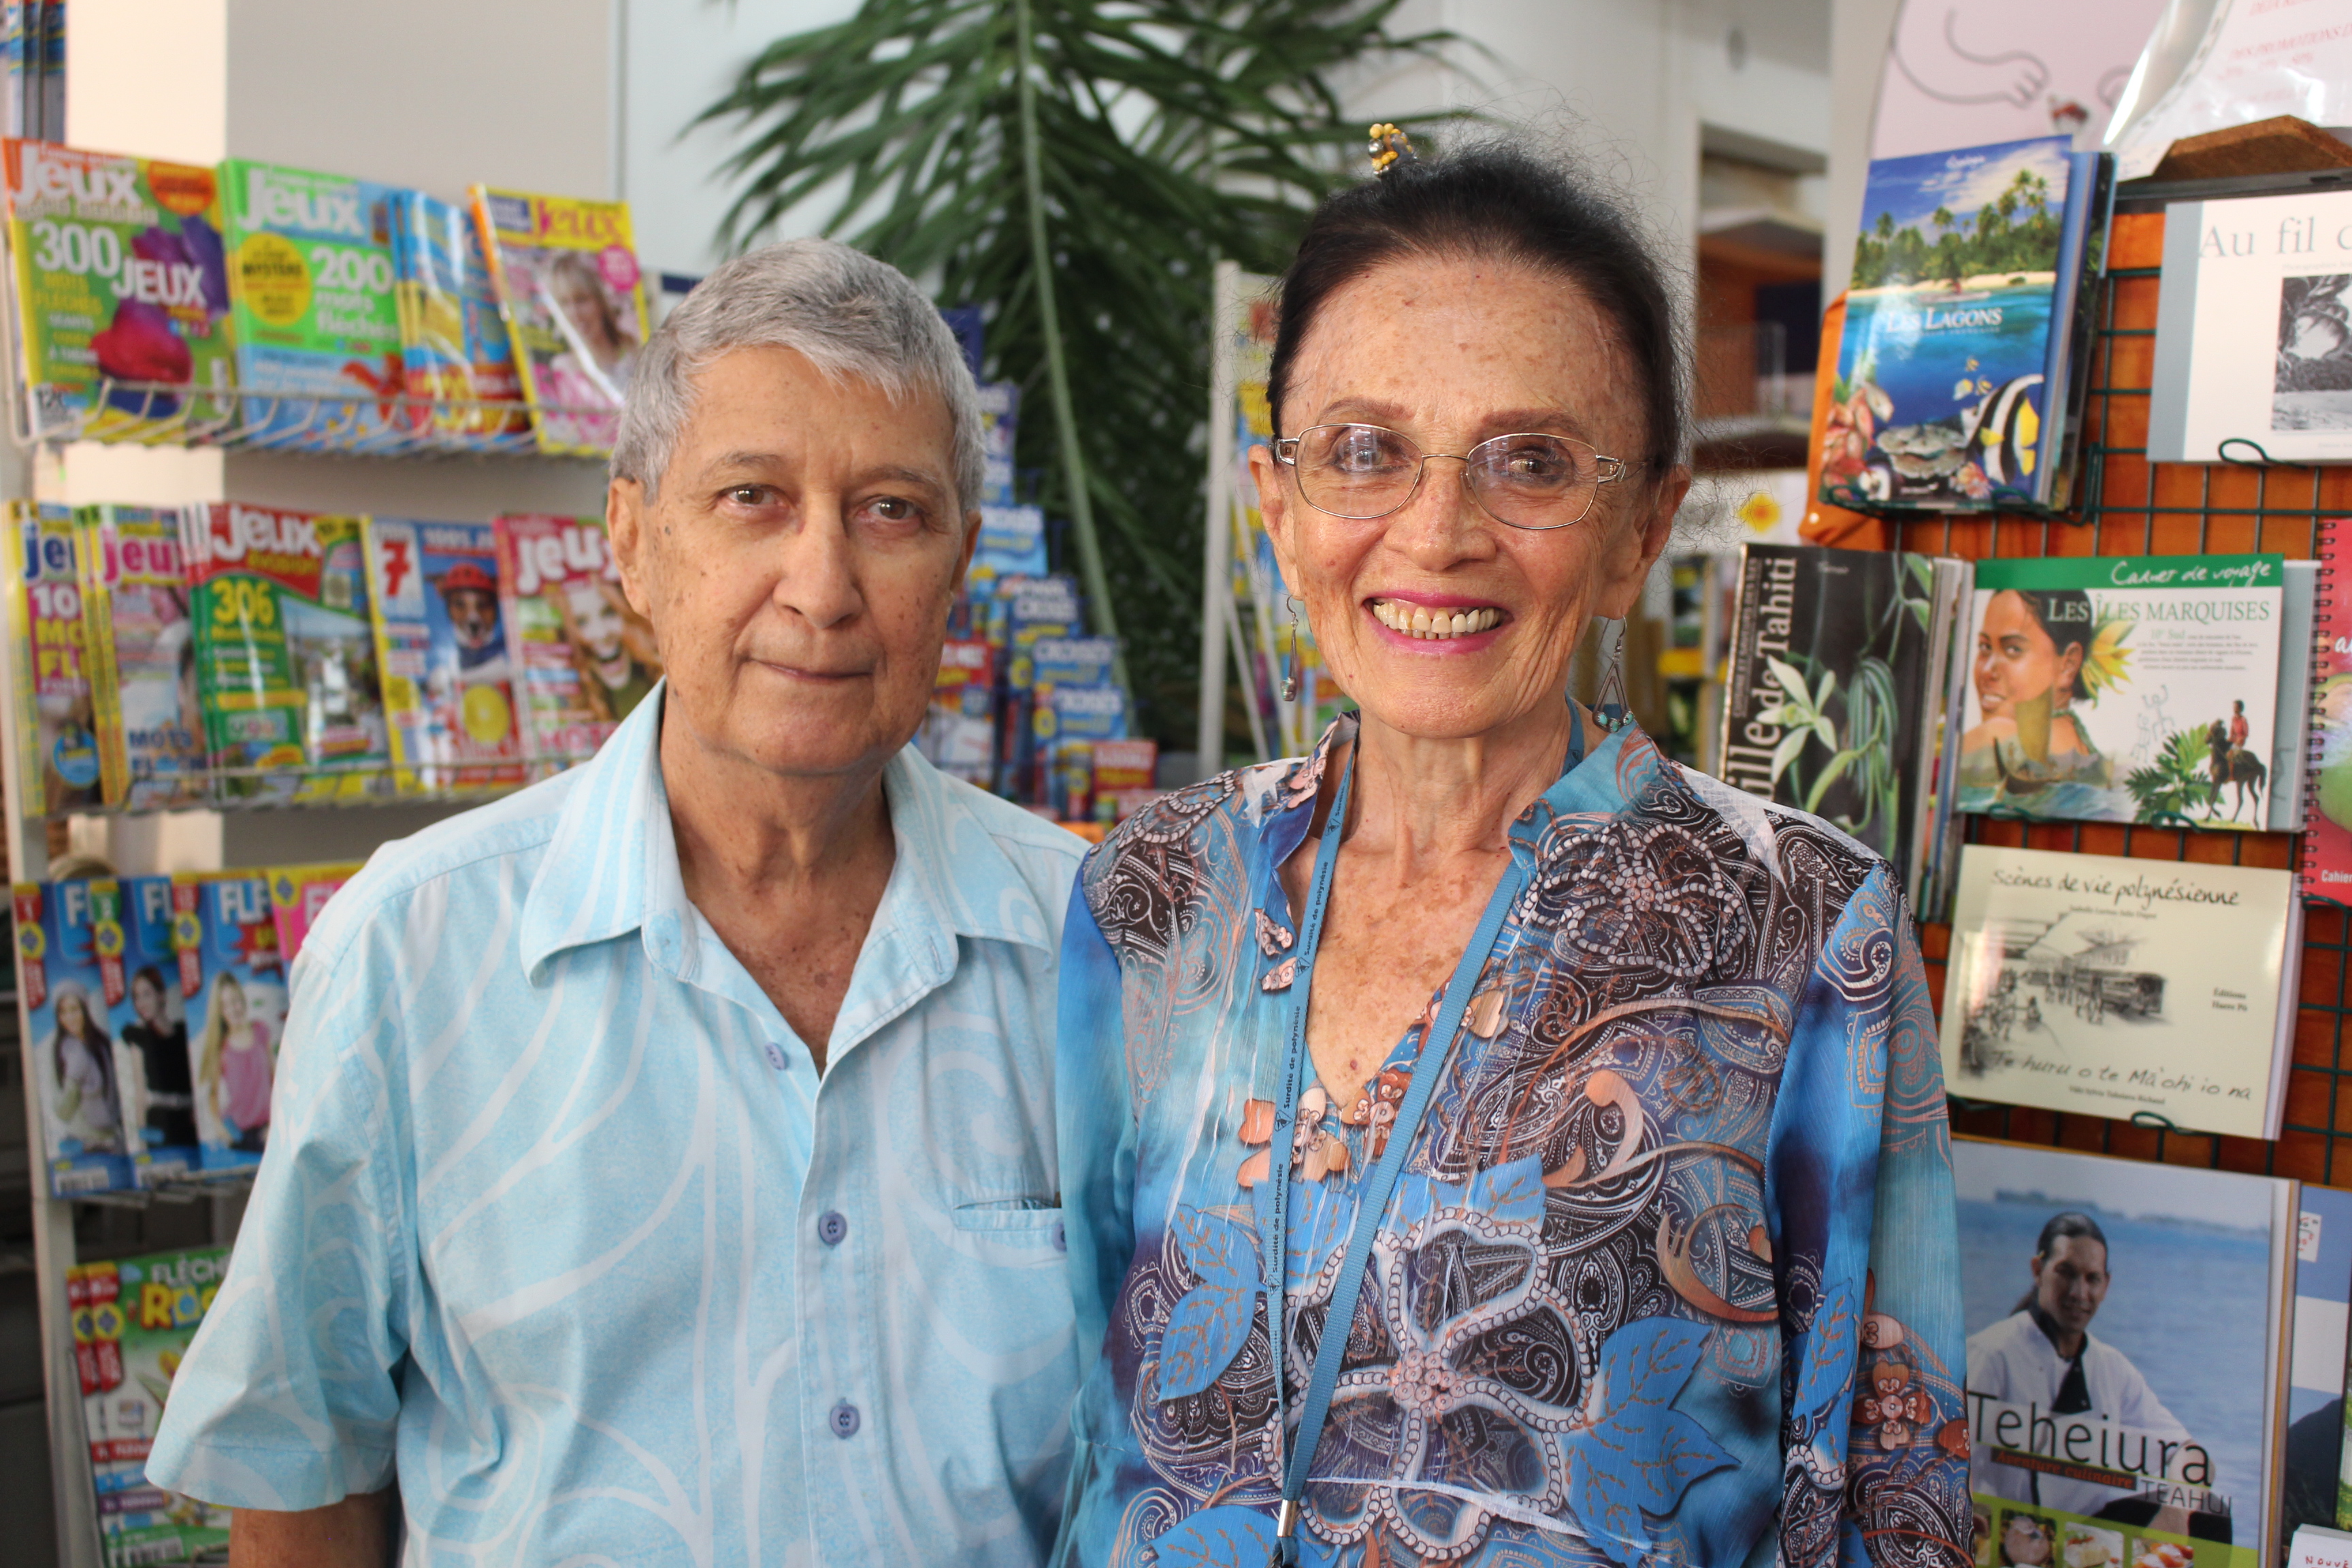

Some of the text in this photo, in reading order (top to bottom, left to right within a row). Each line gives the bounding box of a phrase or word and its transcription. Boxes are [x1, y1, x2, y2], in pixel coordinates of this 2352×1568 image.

[10, 143, 142, 206] Jeux
[238, 167, 365, 235] Jeux
[31, 219, 121, 278] 300
[2199, 225, 2256, 257] Au
[2276, 216, 2315, 255] fil
[111, 257, 207, 308] JEUX
[310, 247, 393, 295] 200
[1925, 306, 2003, 329] LAGONS
[213, 504, 323, 562] Jeux
[2181, 566, 2208, 581] de
[2213, 560, 2272, 587] voyage
[212, 578, 275, 626] 306
[1756, 555, 1797, 661] Tahiti
[2047, 598, 2091, 622] LES
[2145, 600, 2270, 625] MARQUISES
[1304, 861, 1328, 956] Surdité de polynésie
[2058, 872, 2078, 892] de
[2083, 875, 2112, 895] vie
[2114, 873, 2241, 911] polynésienne
[1284, 1005, 1301, 1109] Surdité de polynésie
[2022, 1054, 2072, 1075] huru
[2078, 1066, 2093, 1079] o
[2098, 1064, 2119, 1082] te
[2228, 1085, 2252, 1101] na
[1275, 1162, 1284, 1215] polynésie
[1273, 1218, 1279, 1231] de
[1967, 1390, 2212, 1487] Teheiura
[1996, 1450, 2134, 1490] Aventure culinaire
